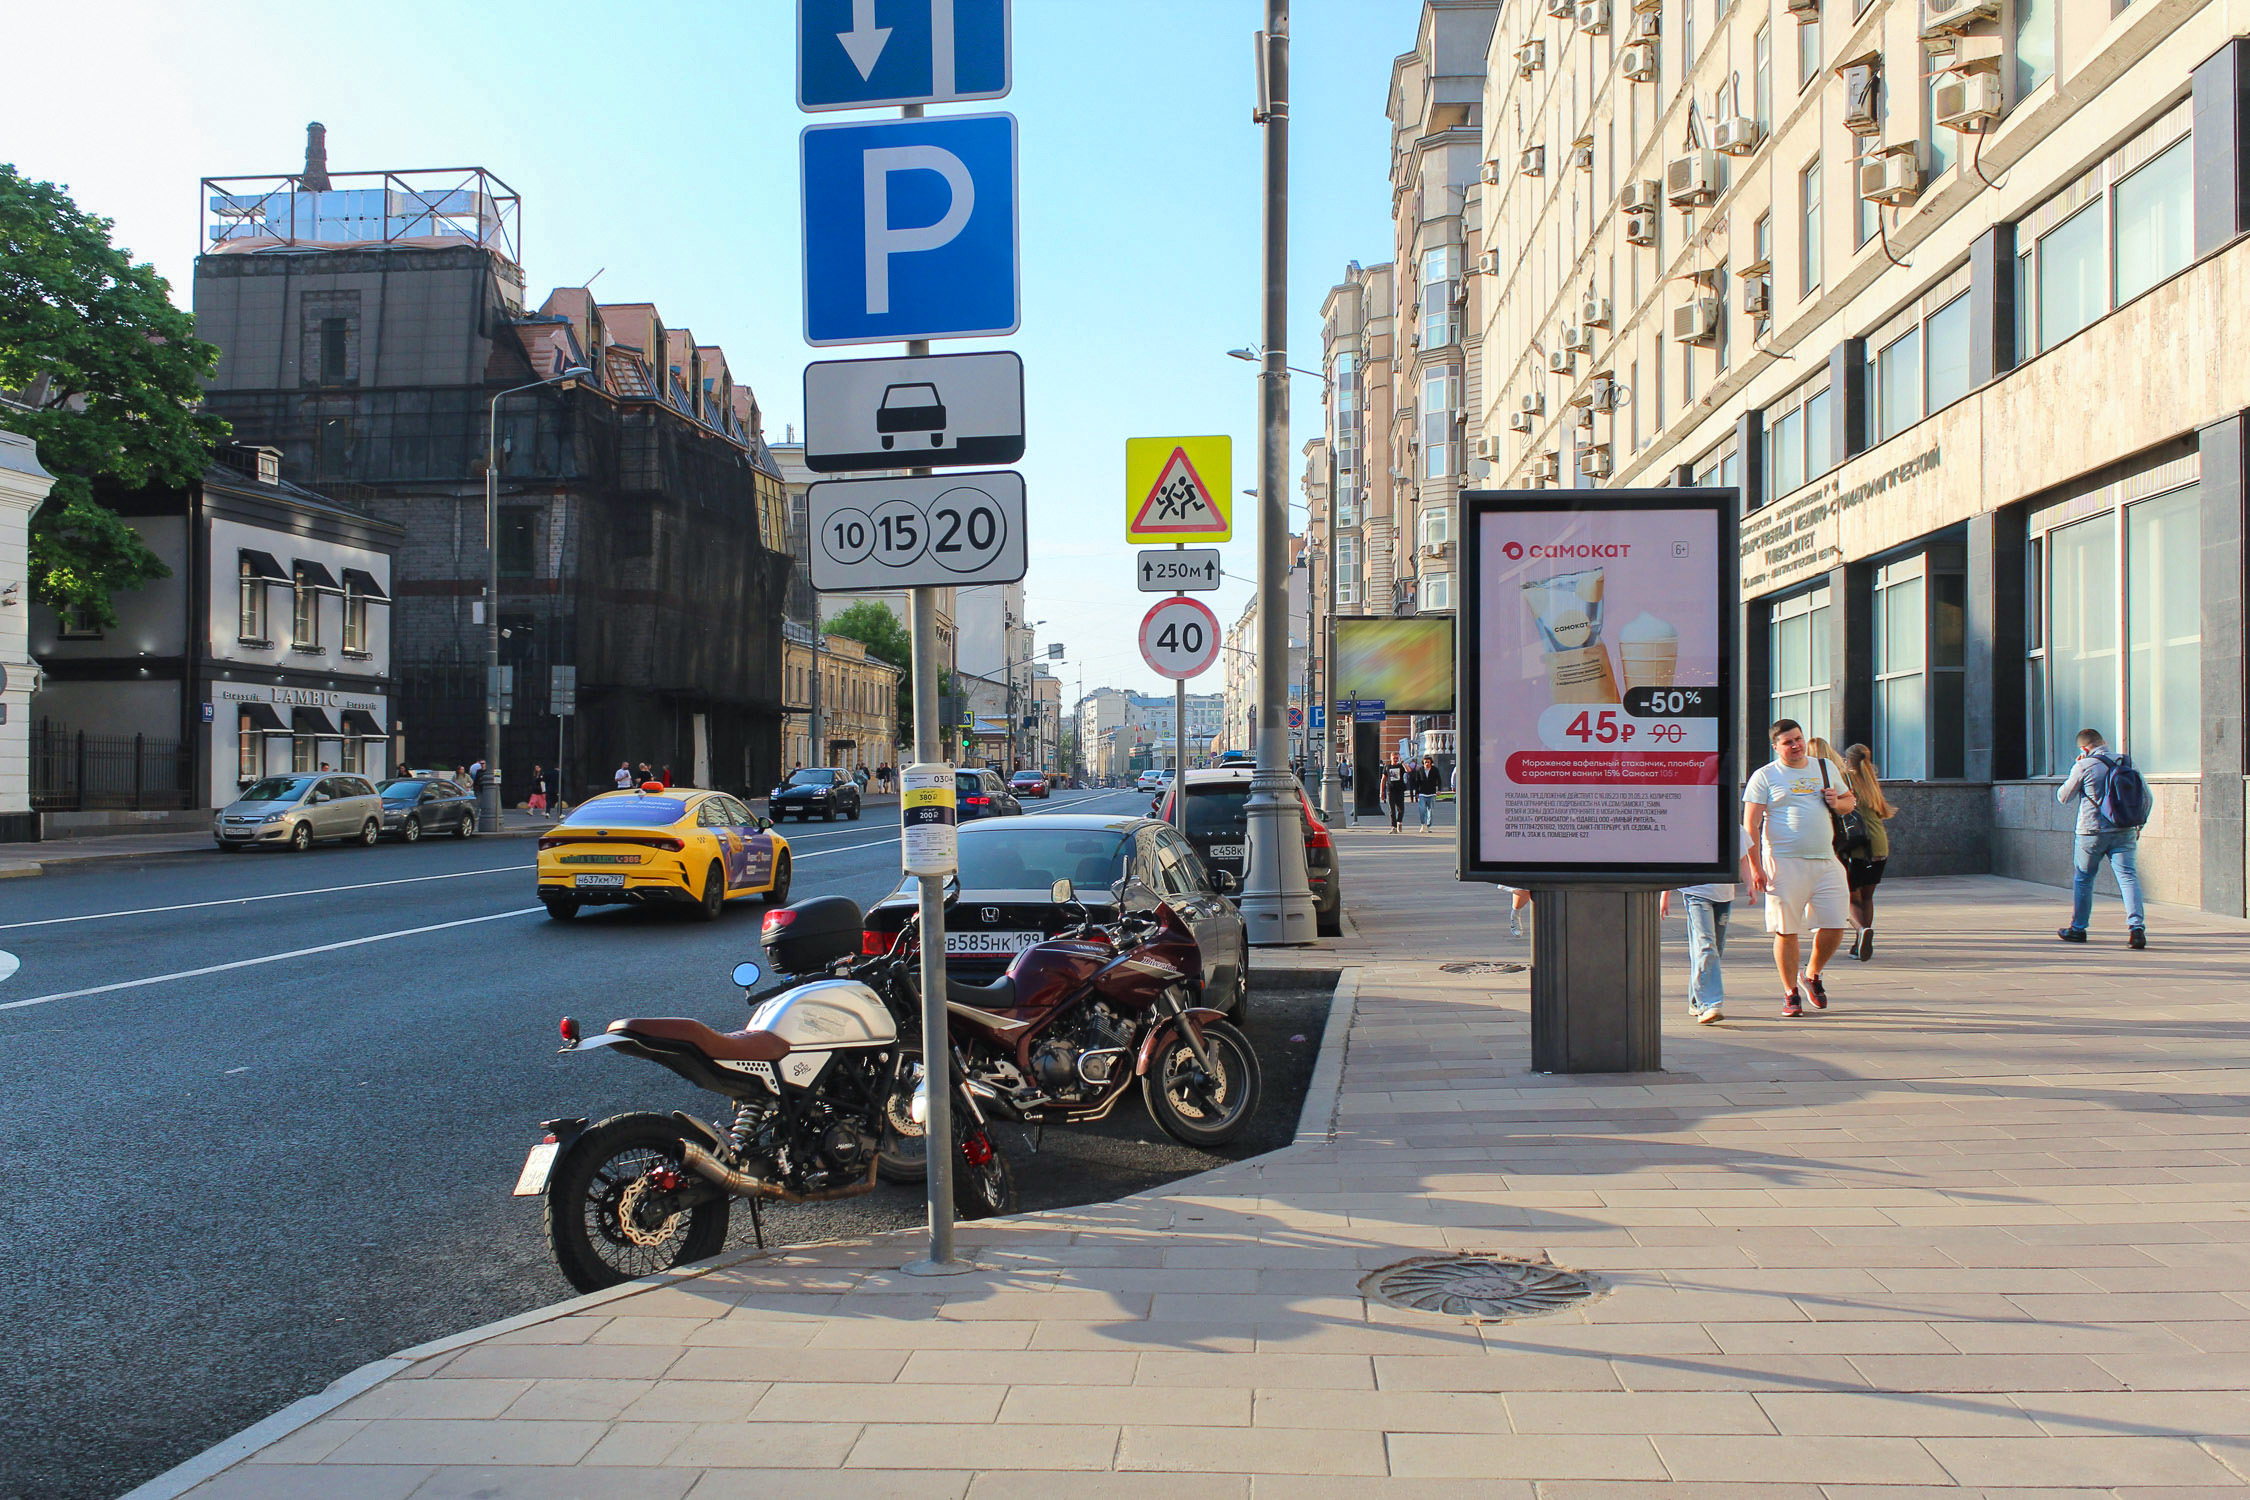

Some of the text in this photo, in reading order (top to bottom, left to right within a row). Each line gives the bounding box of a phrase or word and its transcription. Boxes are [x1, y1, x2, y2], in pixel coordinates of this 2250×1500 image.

[862, 144, 975, 315] P
[833, 506, 996, 553] 10 15 20
[1675, 544, 1687, 555] 6+
[1157, 622, 1203, 653] 40
[271, 688, 339, 708] LAMBIC
[1640, 691, 1702, 713] -50%
[205, 706, 213, 717] 19
[1652, 724, 1682, 744] 90
[1522, 759, 1571, 767] Мороженое
[1573, 759, 1620, 768] вафельный
[1667, 760, 1705, 768] пломбир
[1529, 770, 1570, 778] ароматом
[1604, 769, 1620, 777] 15%
[947, 933, 1040, 951] В585НК 199
[1074, 943, 1105, 952] YAMAHA
[1140, 956, 1177, 972] Diversion
